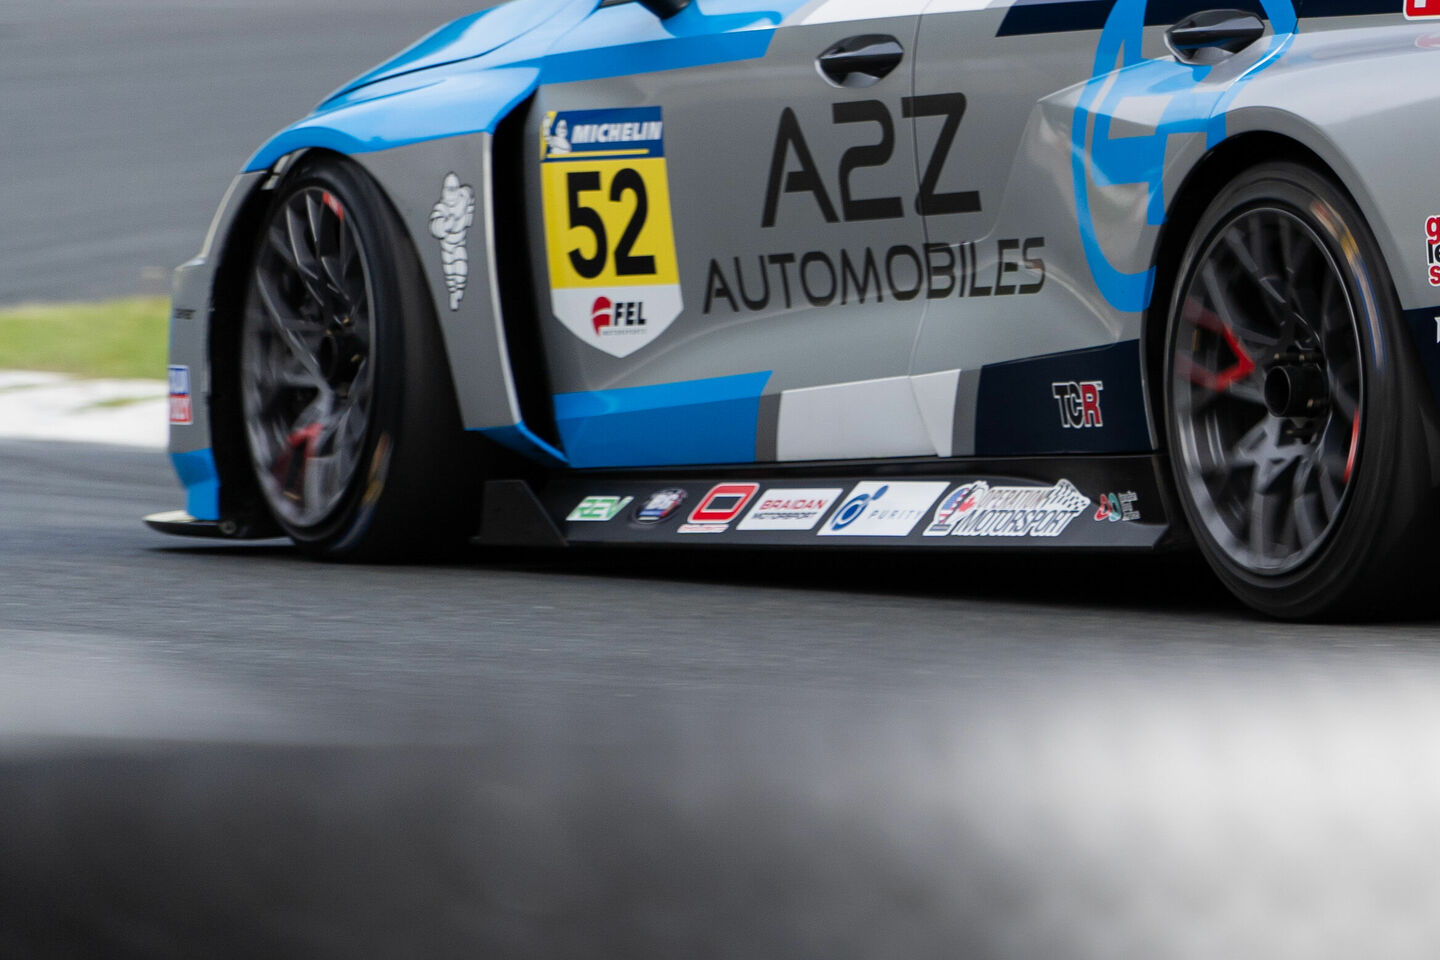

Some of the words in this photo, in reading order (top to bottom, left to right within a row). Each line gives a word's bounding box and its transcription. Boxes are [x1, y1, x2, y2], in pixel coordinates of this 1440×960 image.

[570, 121, 663, 144] MICHELIN
[760, 92, 982, 228] A2Z
[566, 168, 657, 279] 52
[703, 236, 1046, 315] AUTOMOBILES
[613, 301, 648, 327] FEL
[1052, 381, 1103, 429] TCR
[759, 499, 827, 511] BRAIDAN
[953, 509, 1080, 534] MOTORSPORT
